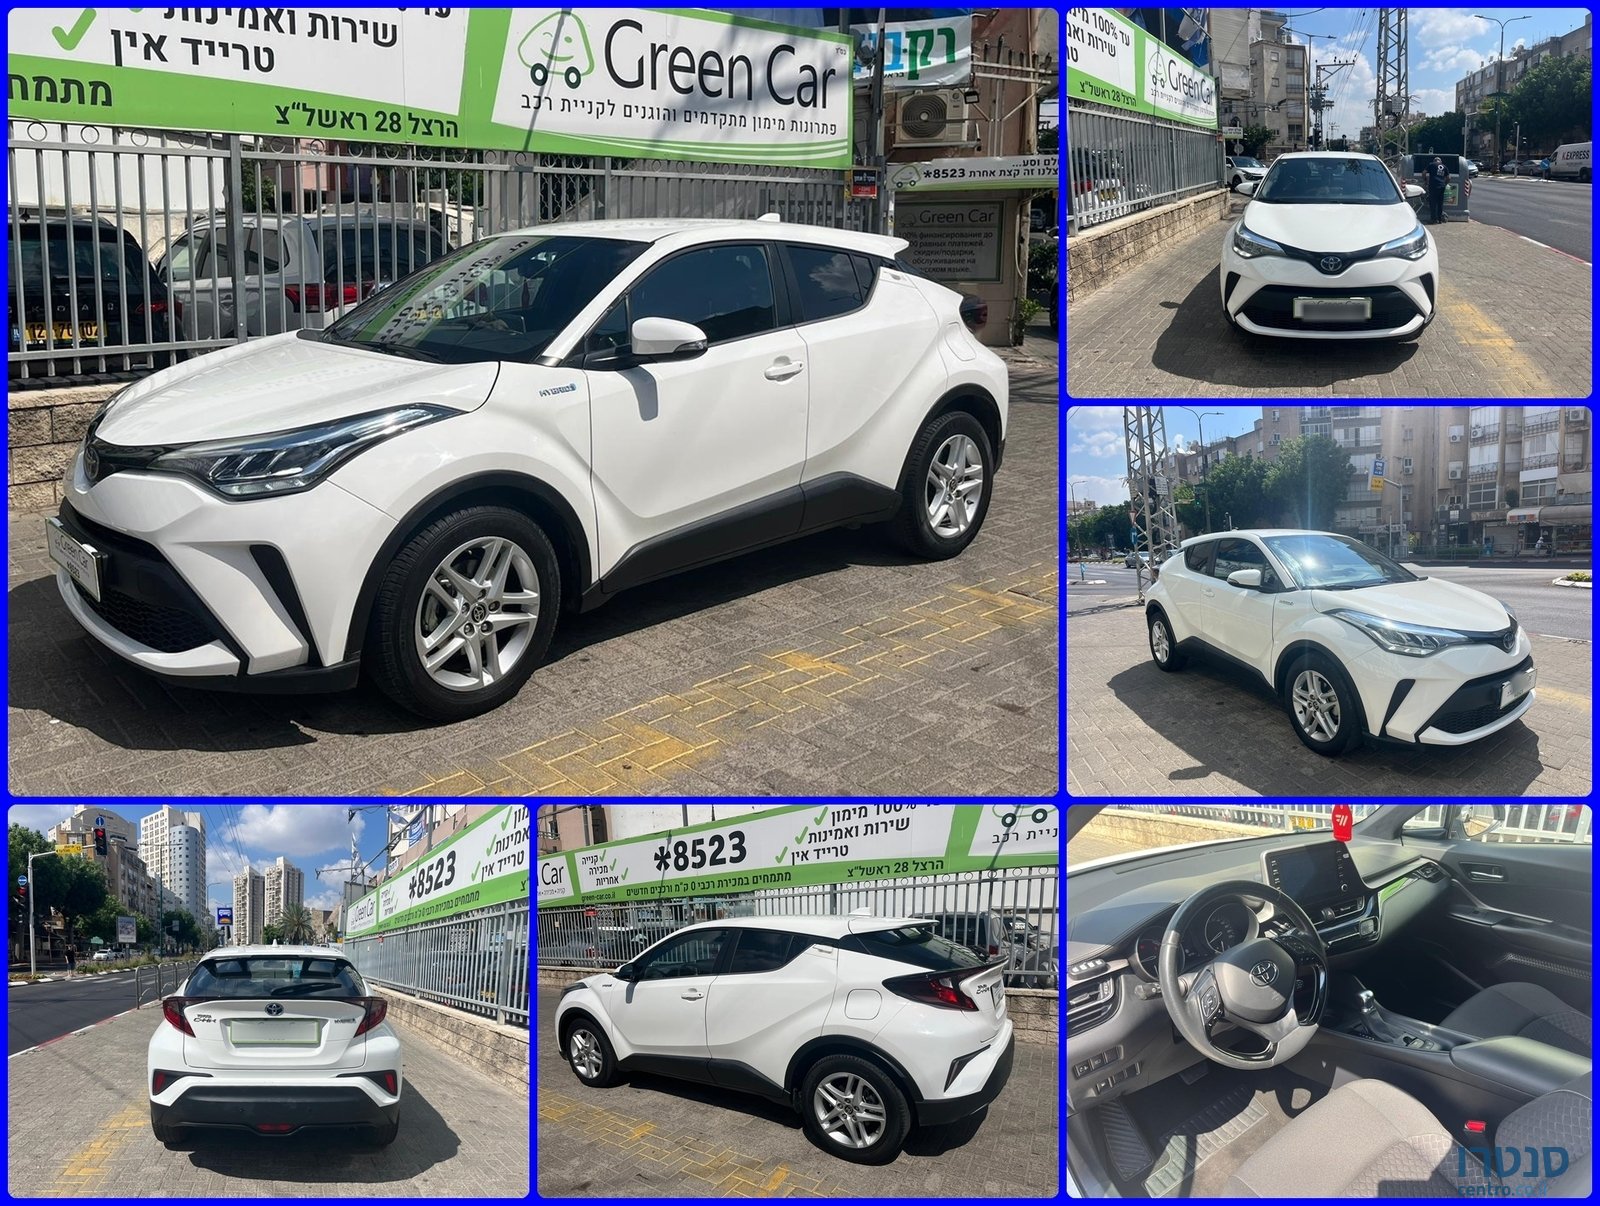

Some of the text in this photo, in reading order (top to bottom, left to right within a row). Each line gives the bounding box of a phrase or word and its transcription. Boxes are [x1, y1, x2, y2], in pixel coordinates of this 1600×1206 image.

[308, 13, 397, 48] שירות
[1092, 13, 1118, 40] 100%
[1087, 32, 1116, 57] שירות
[1119, 30, 1130, 46] עד
[111, 29, 275, 73] טרייד אין
[604, 19, 753, 101] Green
[766, 44, 836, 110] Car
[1168, 59, 1213, 106] Green Car
[1111, 90, 1121, 102] 28
[1121, 92, 1137, 107] הרצל
[375, 110, 402, 134] 28
[521, 94, 837, 136] פתרונות מימון מתקדמים והוגנים לקניית רכב
[407, 112, 459, 138] הרצל
[969, 170, 996, 178] אחרת
[999, 169, 1020, 178] קצת
[1024, 168, 1035, 176] זה
[919, 209, 994, 224] Green Car
[808, 817, 910, 844] שירות ואמינות
[992, 832, 1019, 844] רכב
[581, 854, 599, 866] קנייה
[791, 845, 849, 866] טרייד אין
[481, 850, 524, 882] טרייד אין
[589, 865, 609, 876] מכירה
[893, 862, 909, 874] 28
[913, 859, 944, 872] הרצל
[541, 862, 564, 886] Car
[596, 875, 619, 887] אחריות
[752, 872, 792, 885] מתמחים
[691, 882, 696, 891] 0
[698, 882, 716, 890] רכבי
[717, 876, 750, 888] במכירת
[626, 887, 648, 896] חדשים
[650, 885, 673, 895] ורכבים
